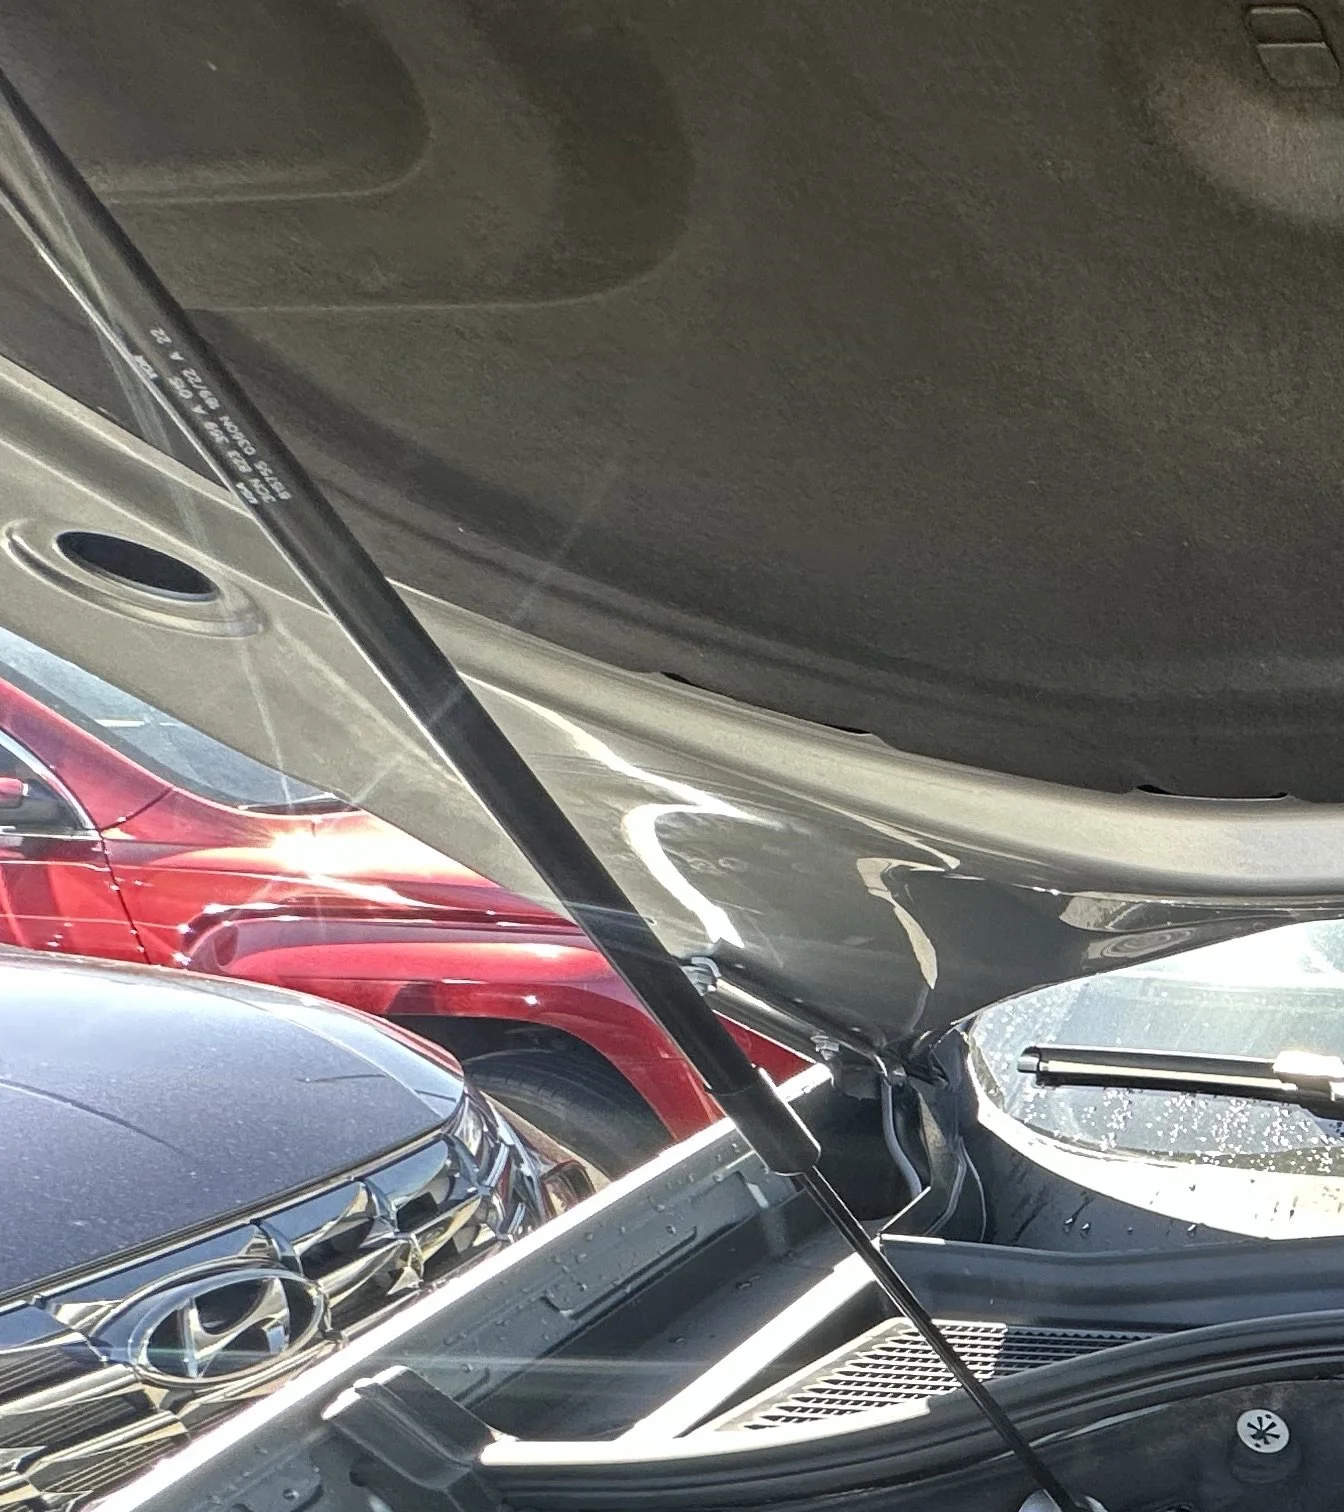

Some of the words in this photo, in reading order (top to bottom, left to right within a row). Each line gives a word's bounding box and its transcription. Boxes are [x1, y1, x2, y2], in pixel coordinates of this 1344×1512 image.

[149, 327, 172, 344] 22
[169, 350, 184, 359] A
[190, 403, 208, 414] A
